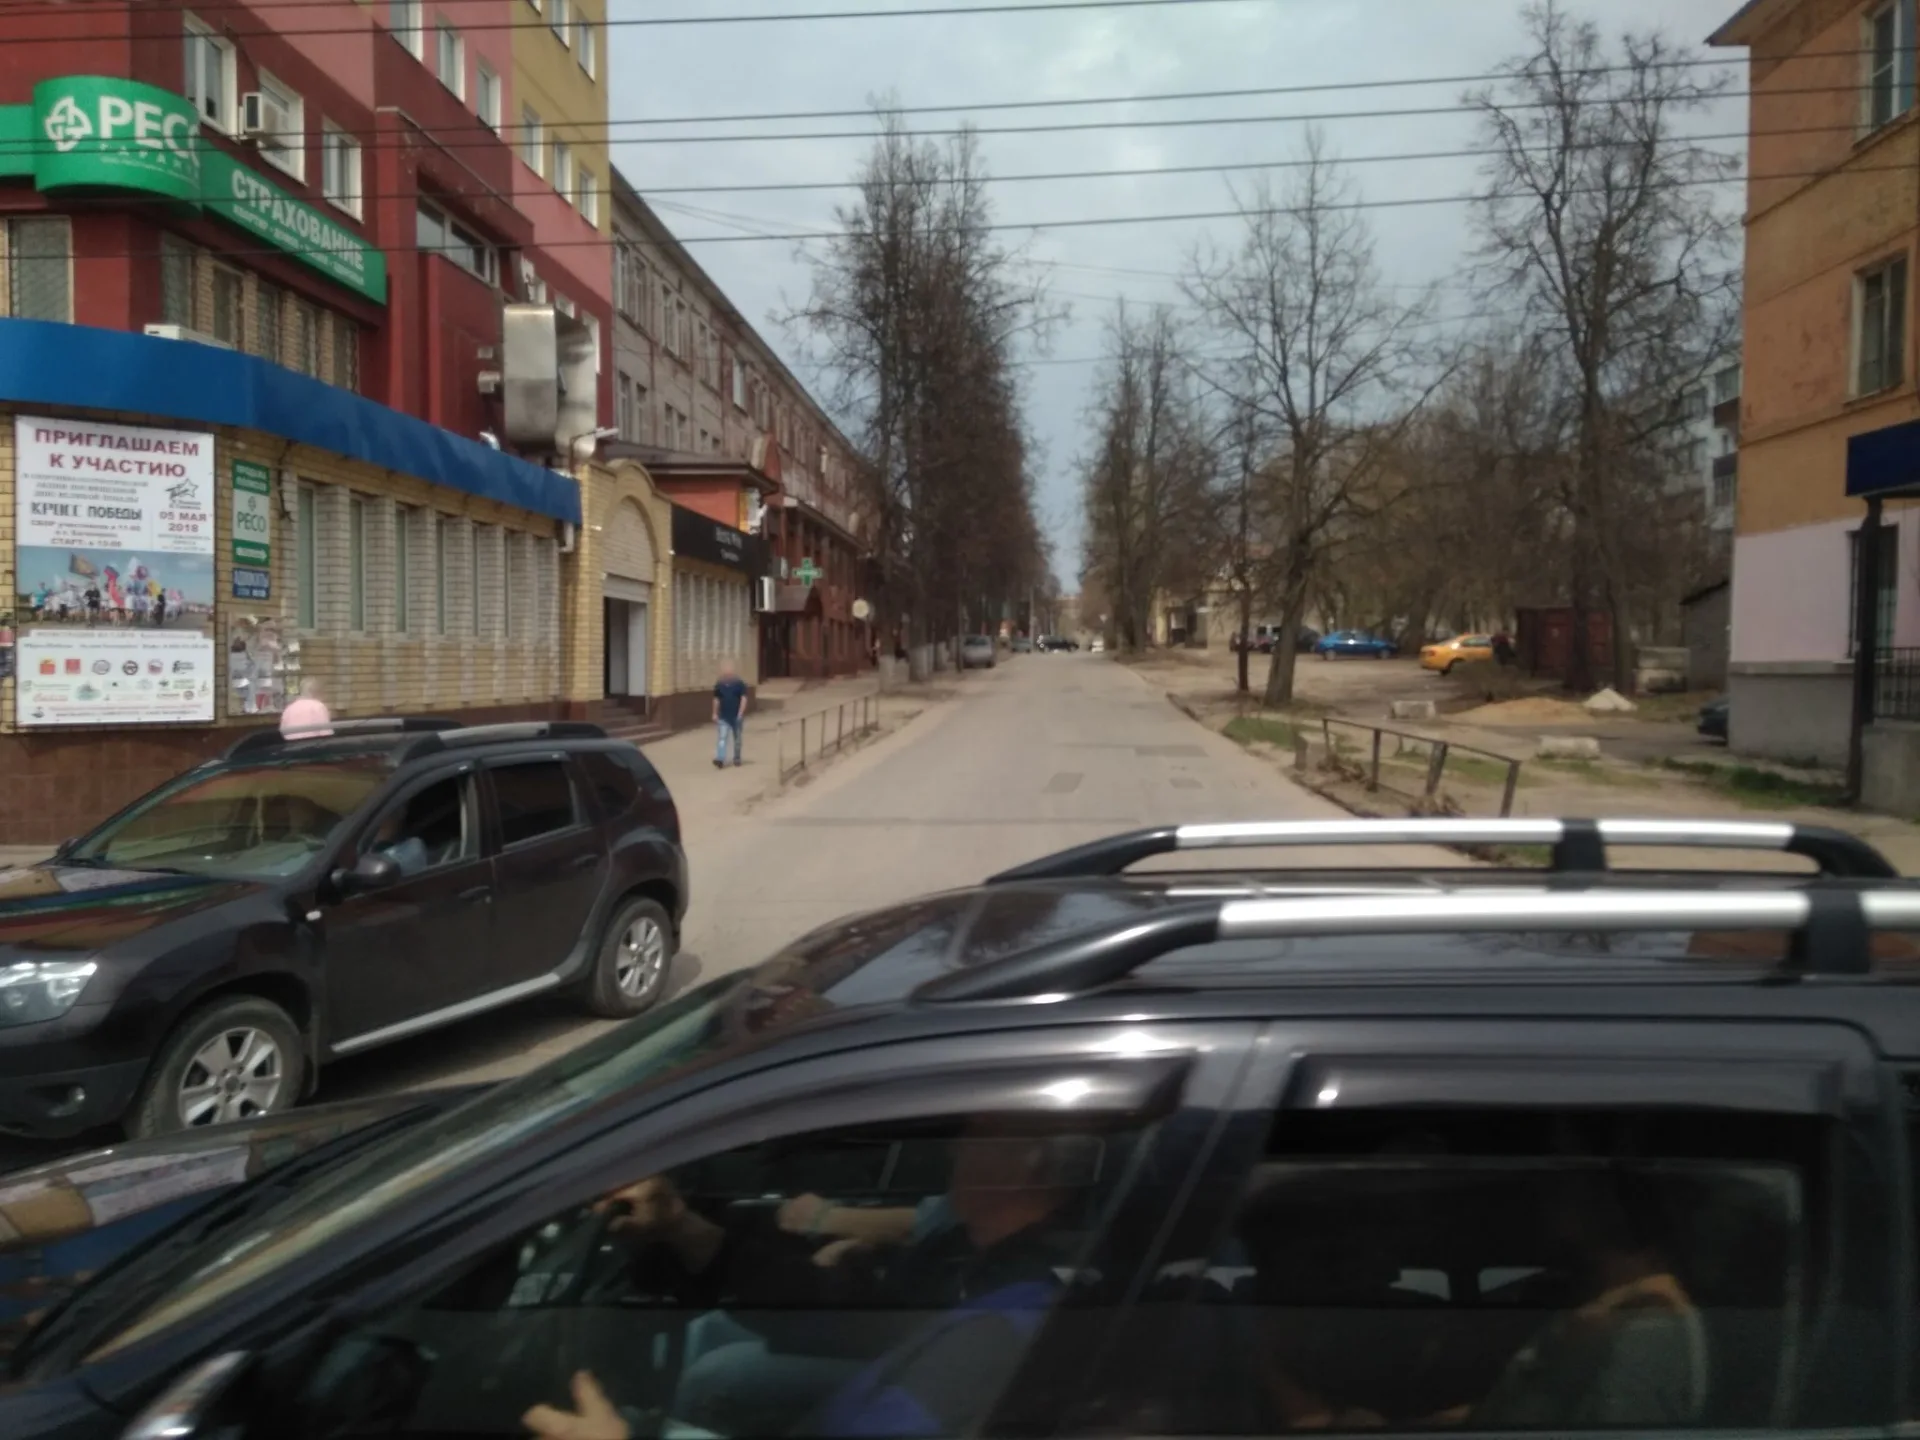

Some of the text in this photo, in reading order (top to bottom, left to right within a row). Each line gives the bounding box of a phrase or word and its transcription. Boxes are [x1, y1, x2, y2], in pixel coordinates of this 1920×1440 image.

[232, 168, 364, 272] СТРАХОВАНИЕ
[35, 428, 199, 456] ПРИГЛАШАЕМ
[49, 453, 186, 478] К УЧАСТИЮ
[87, 506, 142, 521] ПОБЕДЫ
[179, 512, 207, 522] МАЯ
[236, 511, 267, 533] РЕСО
[168, 522, 199, 533] 2018
